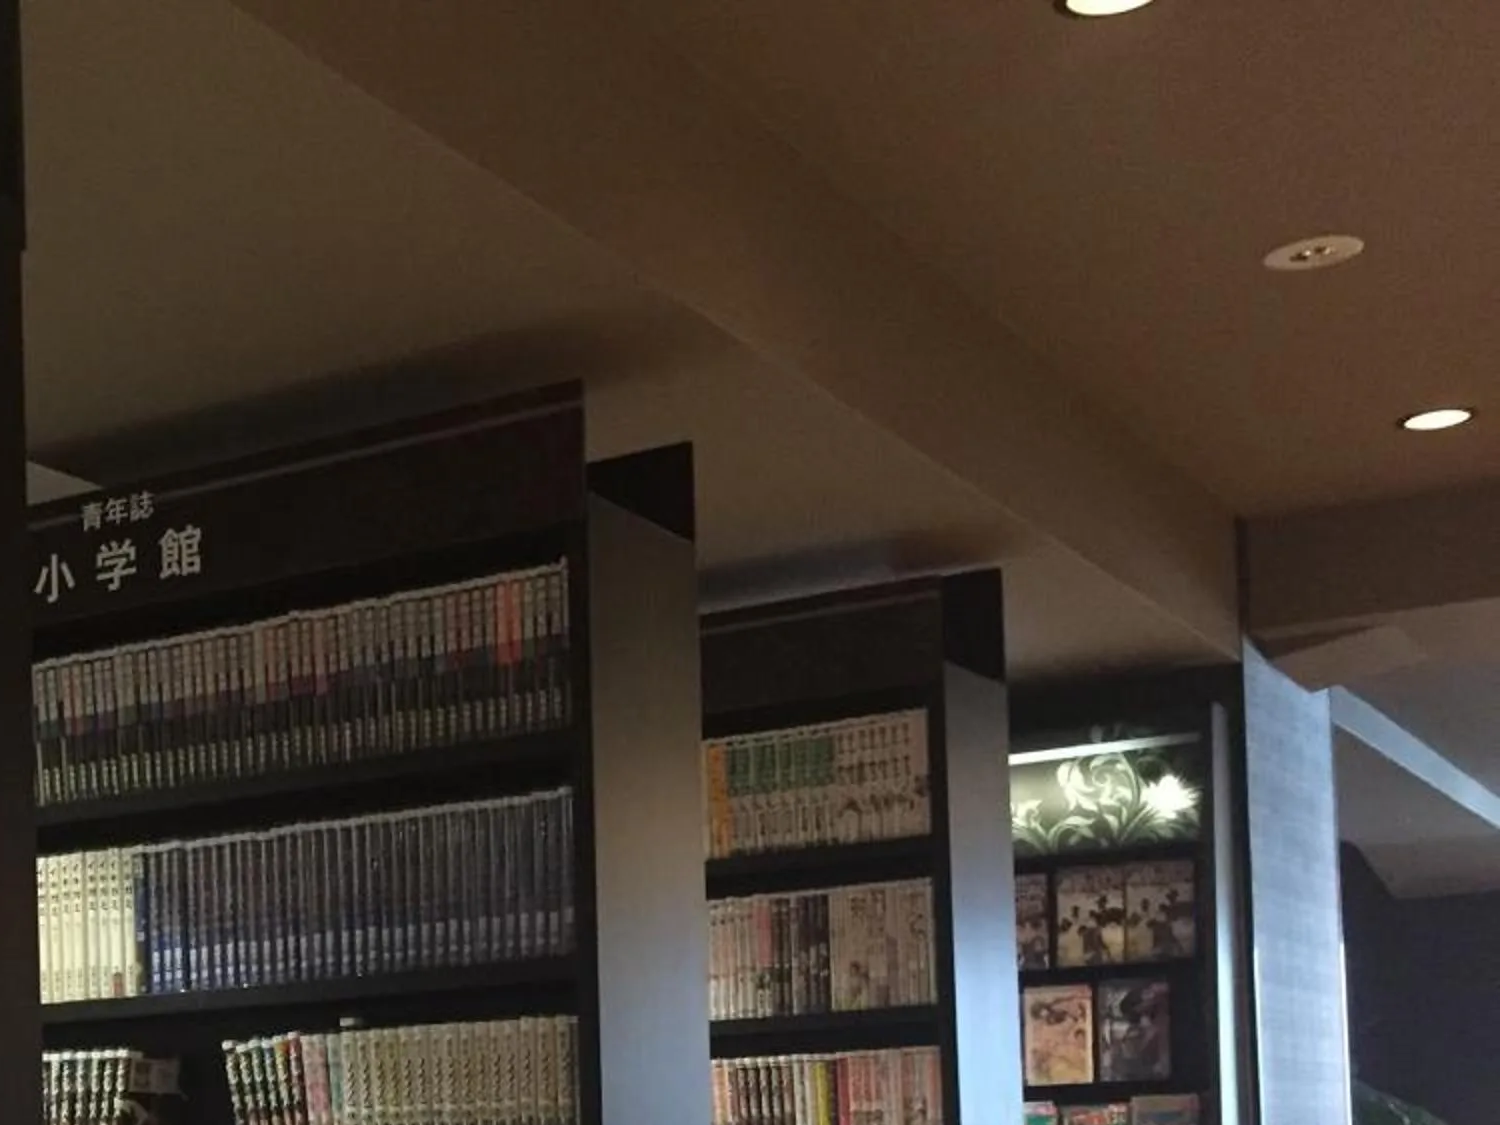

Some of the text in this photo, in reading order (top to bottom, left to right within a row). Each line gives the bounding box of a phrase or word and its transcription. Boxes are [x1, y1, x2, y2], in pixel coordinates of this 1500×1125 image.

[82, 491, 153, 532] 青年誌
[34, 525, 202, 603] 小学館
